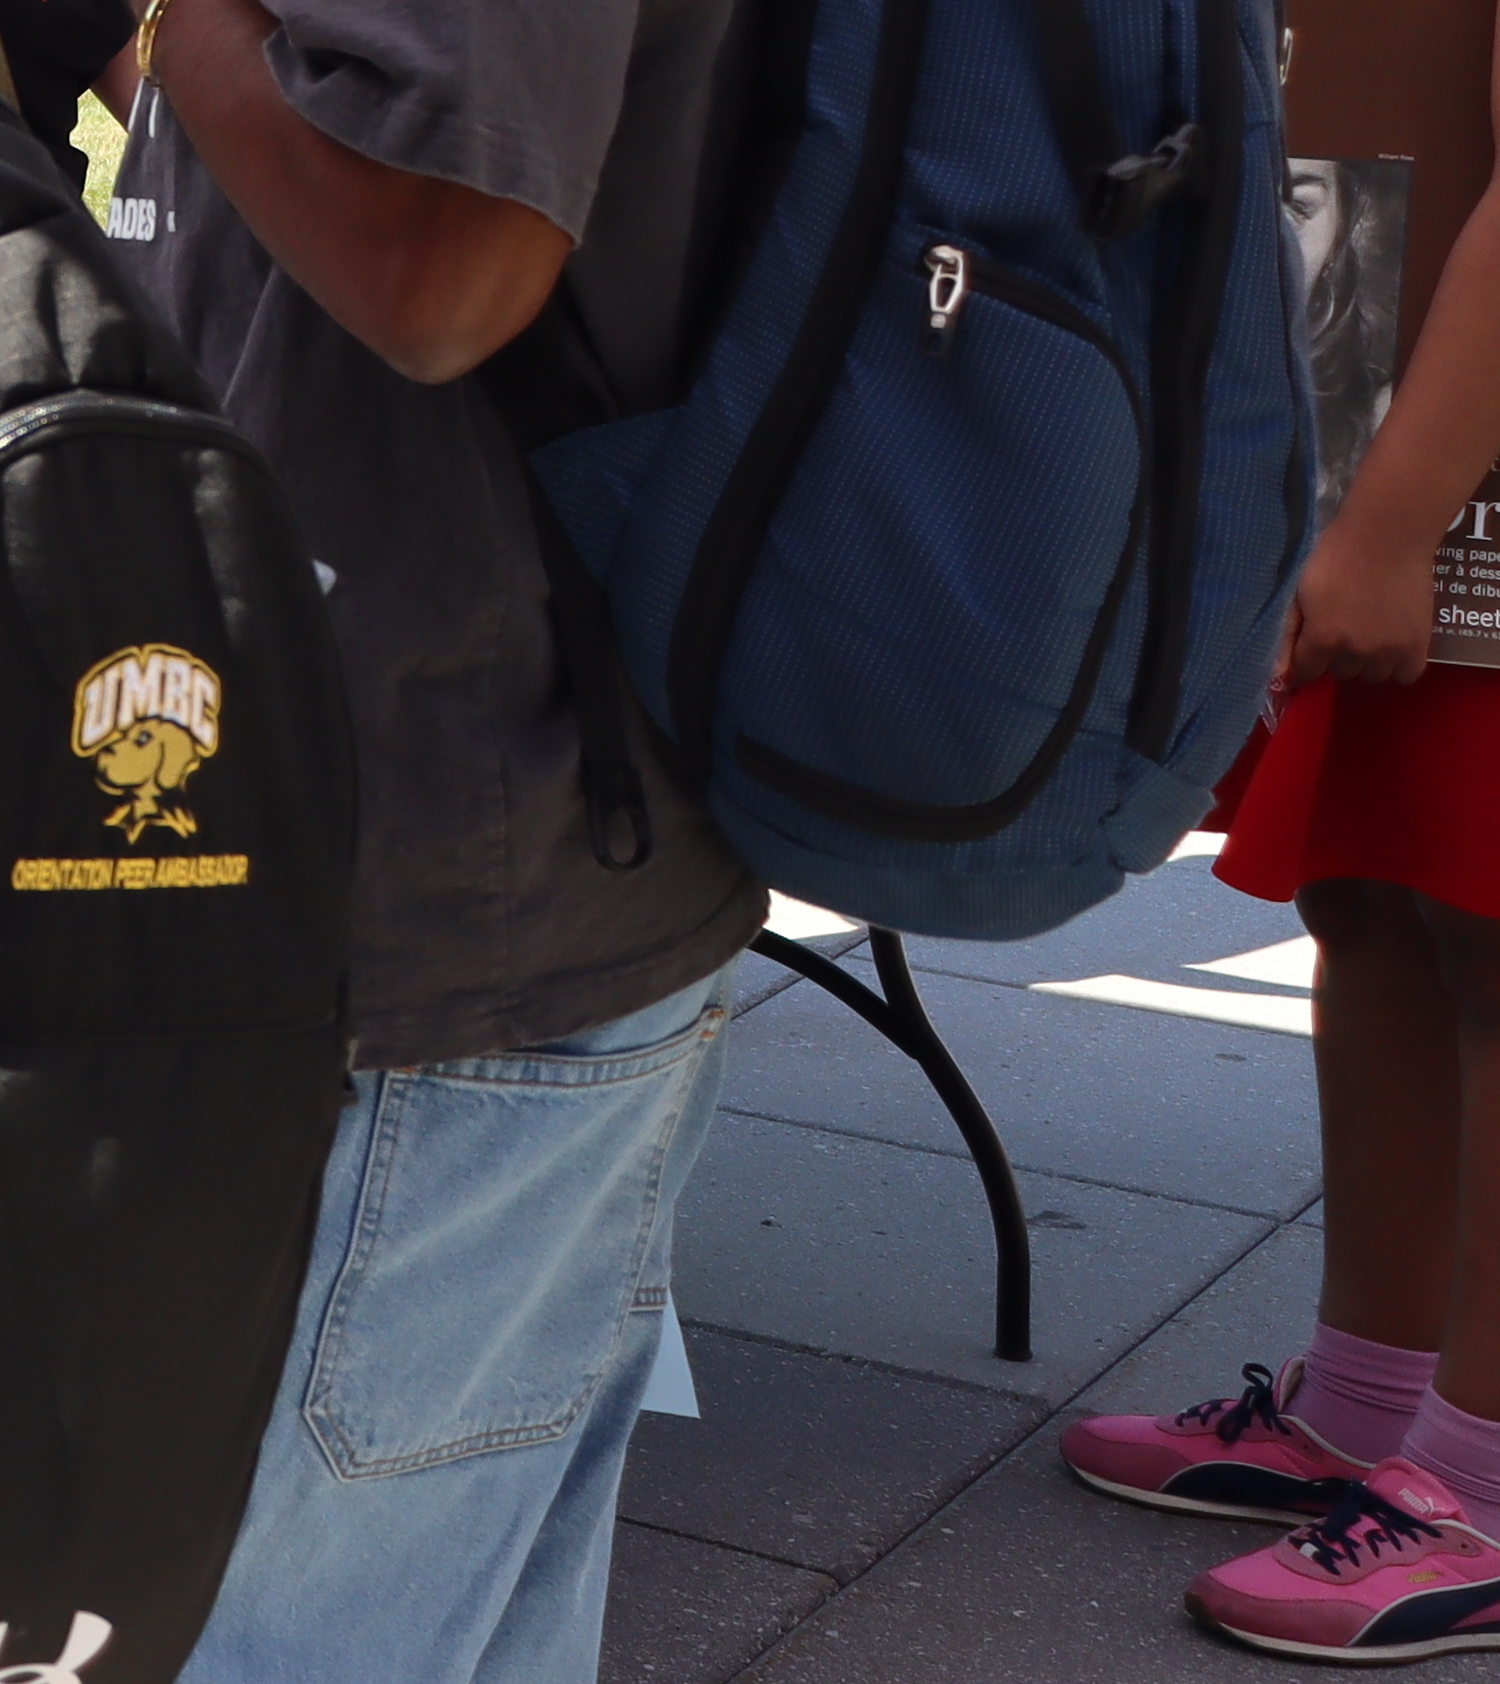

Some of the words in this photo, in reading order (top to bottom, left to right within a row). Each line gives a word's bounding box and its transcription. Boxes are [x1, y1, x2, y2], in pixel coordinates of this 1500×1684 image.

[1456, 563, 1465, 577] à
[1449, 581, 1468, 595] de
[79, 653, 219, 752] UMBC
[11, 857, 114, 890] ORIENTATION
[114, 857, 155, 890] PEER
[155, 853, 249, 888] AMBASSADOR
